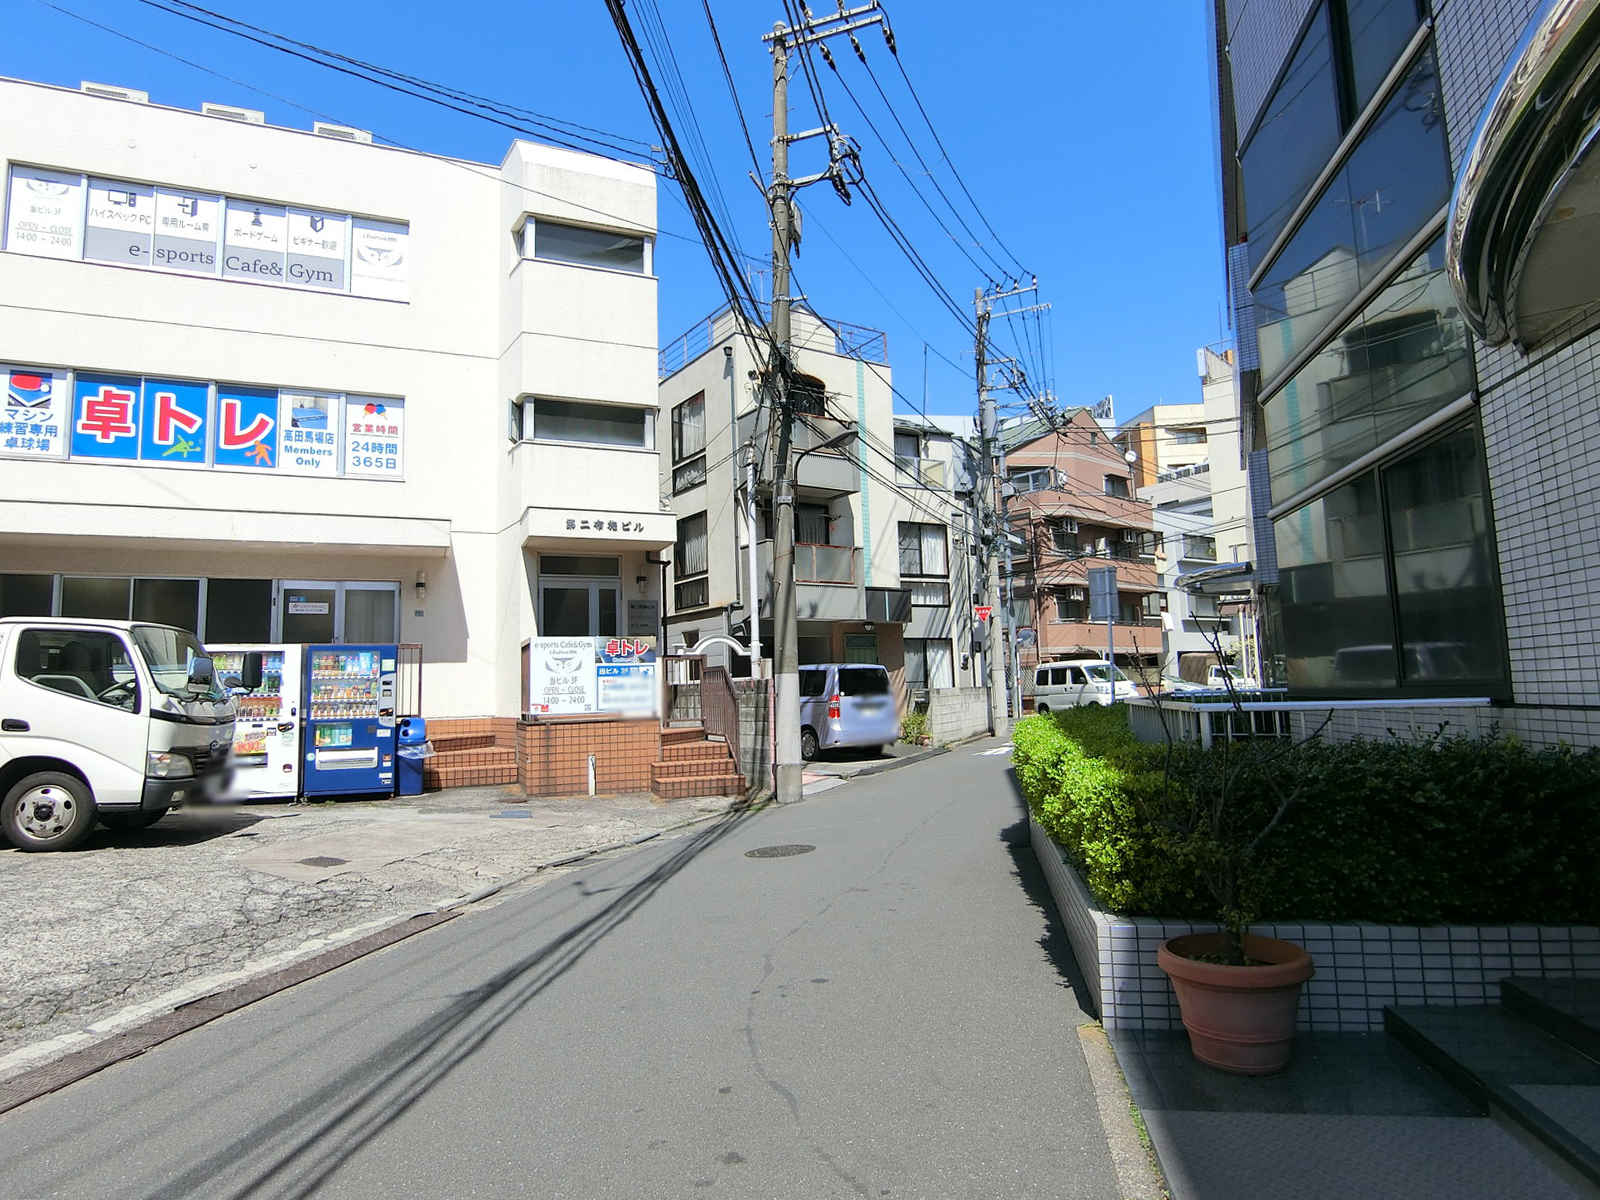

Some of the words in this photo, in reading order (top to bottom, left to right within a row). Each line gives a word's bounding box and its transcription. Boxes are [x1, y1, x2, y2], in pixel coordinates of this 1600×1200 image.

[54, 206, 62, 216] 3F
[90, 208, 137, 223] ハイスペック
[139, 213, 152, 225] PC
[18, 221, 38, 231] OPEN
[50, 225, 72, 235] CLOSE
[16, 231, 37, 242] 14:00
[50, 235, 72, 246] 24:00
[234, 228, 278, 243] ボードゲーム
[4, 408, 54, 422] マシン
[0, 421, 58, 438] 練習専用
[352, 423, 399, 436] 営業時間
[4, 437, 51, 452] 卓球場
[283, 430, 335, 446] 高田馬場店
[284, 445, 333, 457] Members
[352, 441, 398, 455] 24時間
[296, 457, 321, 468] Only
[352, 456, 397, 470] 365日
[534, 640, 559, 650] e-sports
[606, 639, 650, 656] 卓トレ
[599, 667, 619, 675] 当ビル
[549, 676, 568, 686] 当ビル
[571, 676, 578, 684] 3F
[543, 686, 560, 694] OPEN
[567, 685, 585, 693] CLOSE
[543, 696, 559, 705] 14:00
[568, 695, 585, 704] 24:00
